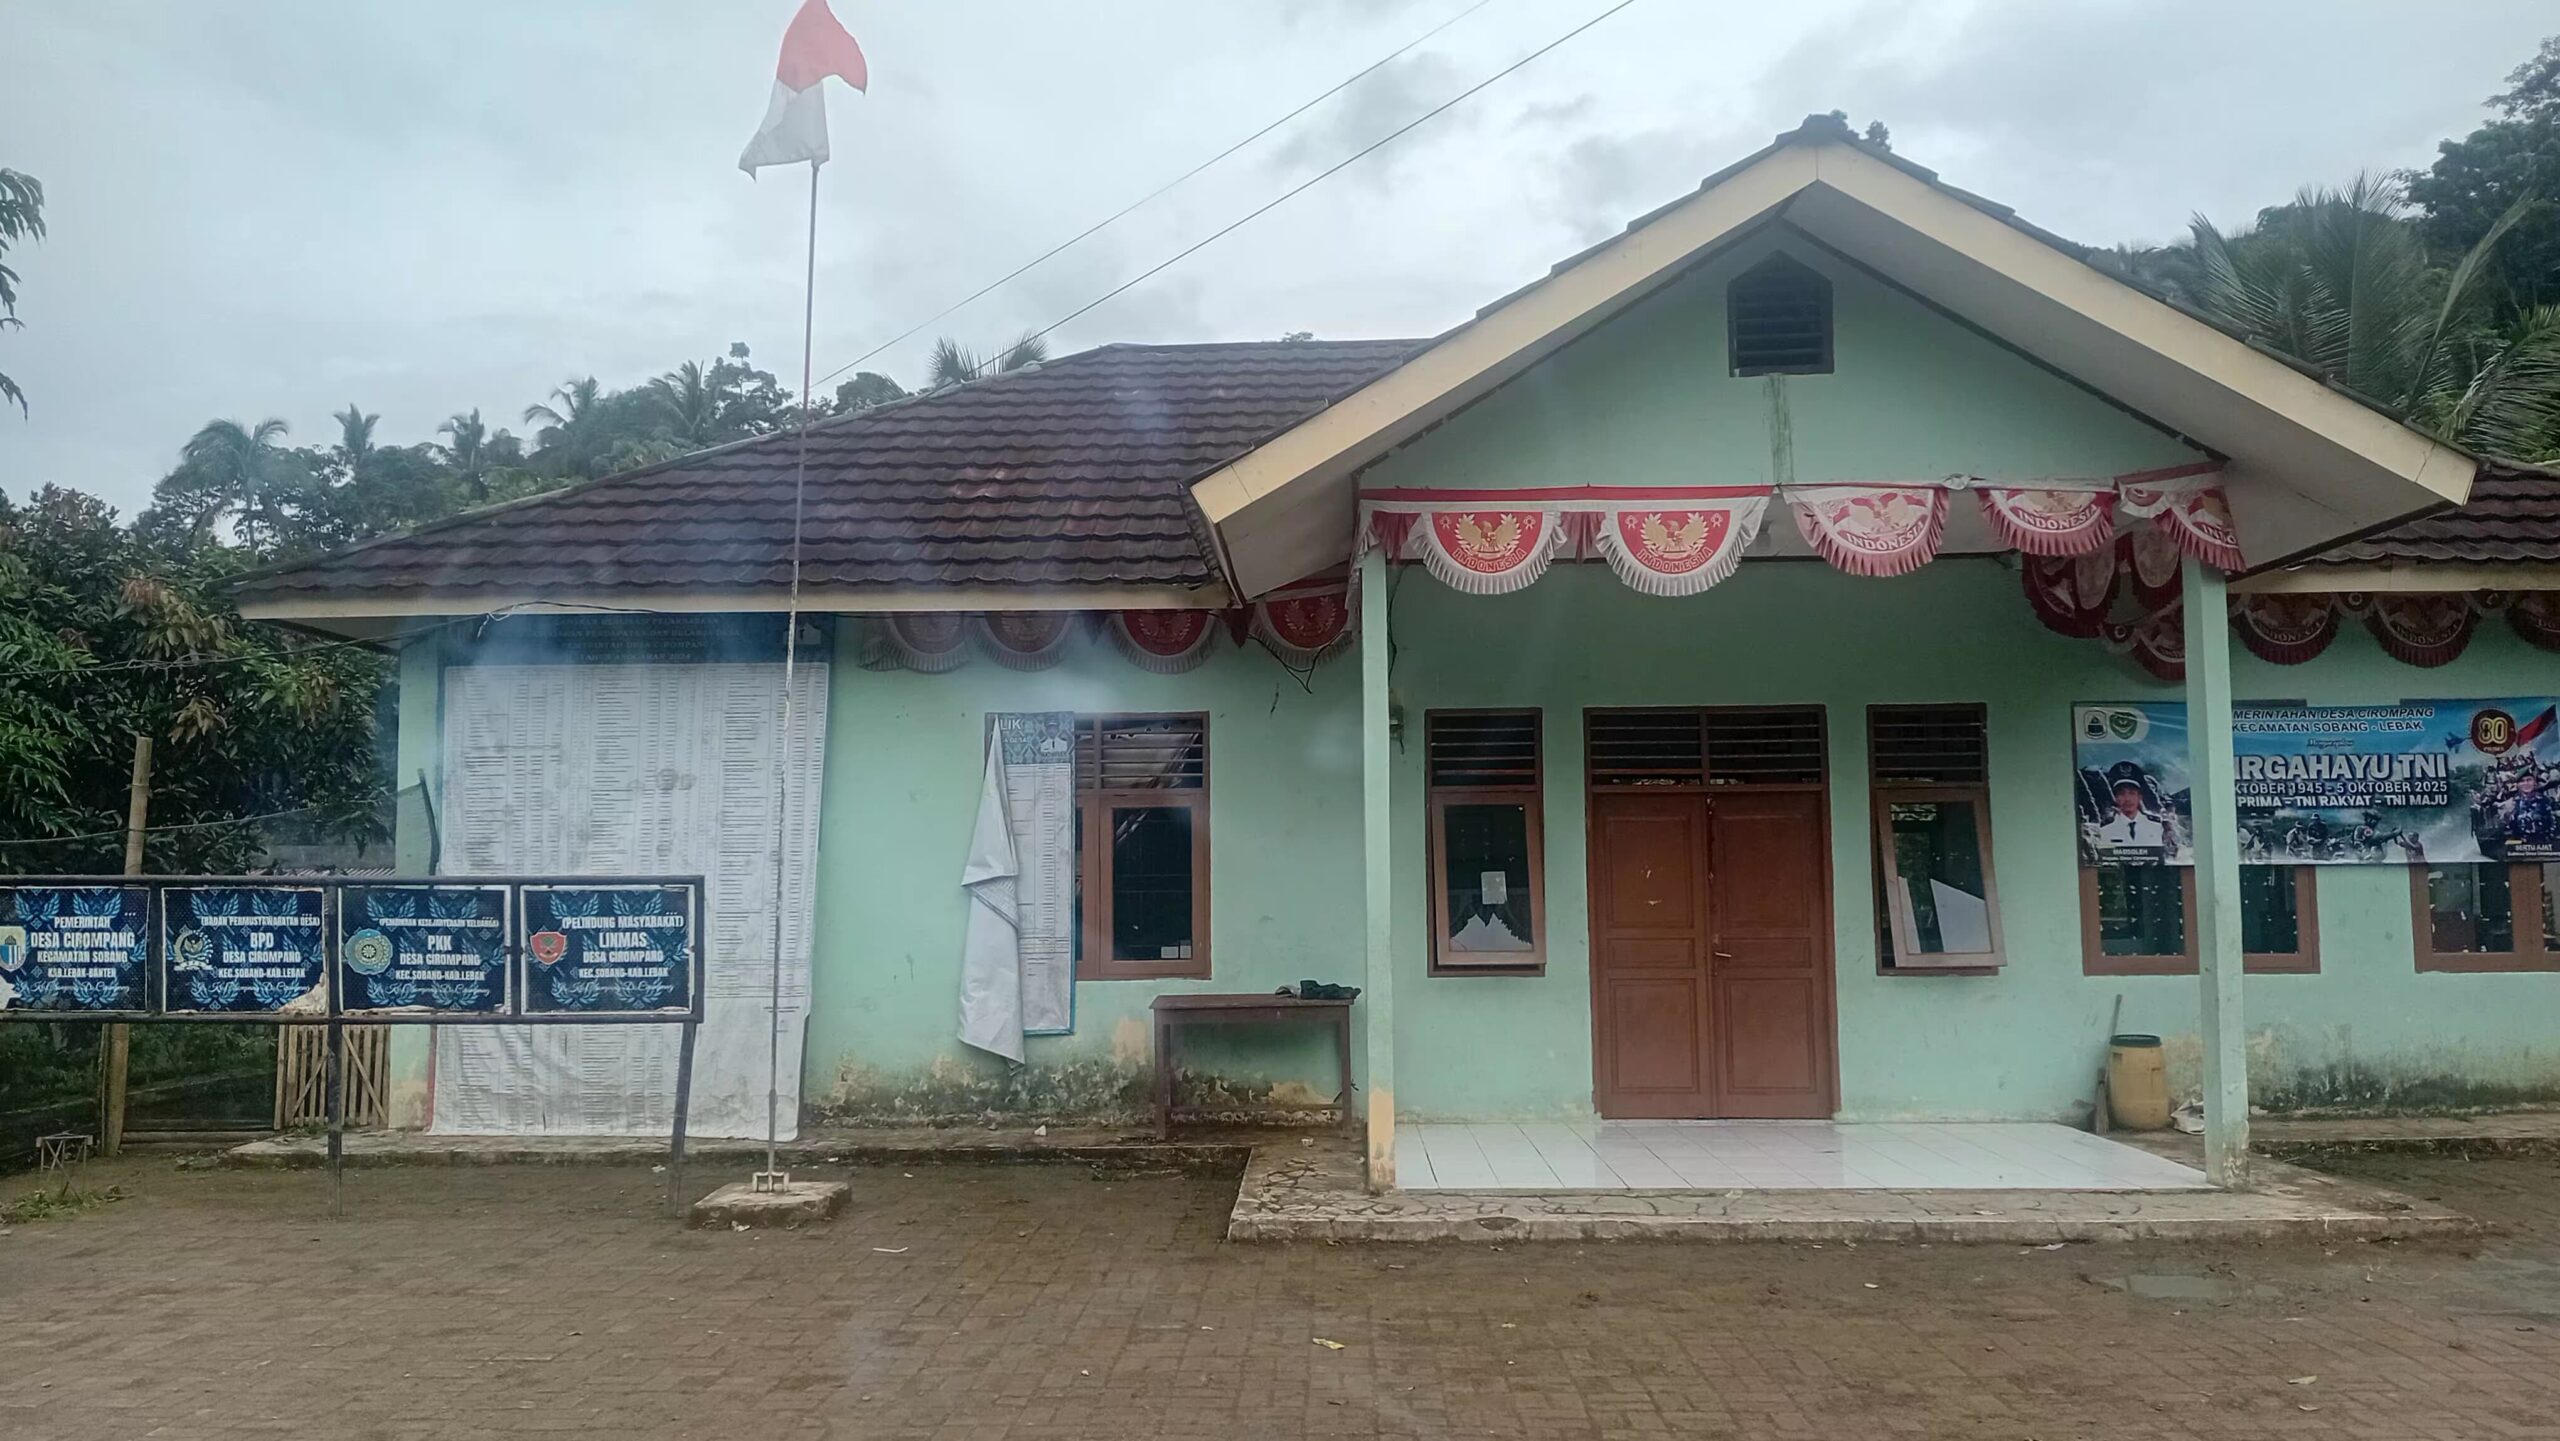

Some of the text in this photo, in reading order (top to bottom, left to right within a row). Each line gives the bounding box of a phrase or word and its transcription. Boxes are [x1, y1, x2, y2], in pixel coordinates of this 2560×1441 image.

[2017, 504, 2097, 530] INDONESIA
[1846, 520, 1924, 551] INDONESIA
[1454, 548, 1527, 573] INDONESIA
[1637, 546, 1712, 573] INDONESIA
[2233, 707, 2434, 720] MERINTAHAN DESA CIROMPANG
[1001, 718, 1021, 730] LIK
[2232, 722, 2310, 733] KECAMATAN
[2313, 721, 2368, 733] SOBANG
[2379, 720, 2424, 732] LEBAK
[2478, 717, 2509, 744] 80
[2234, 754, 2447, 780] IRGAHAYU TNI
[2235, 782, 2286, 794] KTOBER
[2291, 782, 2323, 794] 1945
[2336, 783, 2344, 793] 5
[2348, 782, 2411, 793] OKTOBER
[2415, 781, 2447, 792] 2025
[2237, 796, 2282, 807] PRIMA
[2295, 796, 2317, 806] TNI
[2320, 796, 2372, 806] RAKYAT
[2385, 795, 2406, 806] TNI
[2410, 794, 2447, 805] MAJU
[54, 916, 111, 928] PEMERINTAH
[562, 915, 684, 929] (PELINDUNG MASYARAKAT)
[30, 931, 135, 949] DESA CIROMPANG
[250, 932, 274, 949] BPD
[427, 935, 452, 951] PKK
[598, 932, 648, 948] LINMAS
[37, 950, 128, 962] KECAMATAN SOBANG
[222, 951, 301, 963] DESA CIROMPANG
[400, 953, 481, 966] DESA CIROMPANG
[583, 950, 664, 963] DESA CIROMPANG
